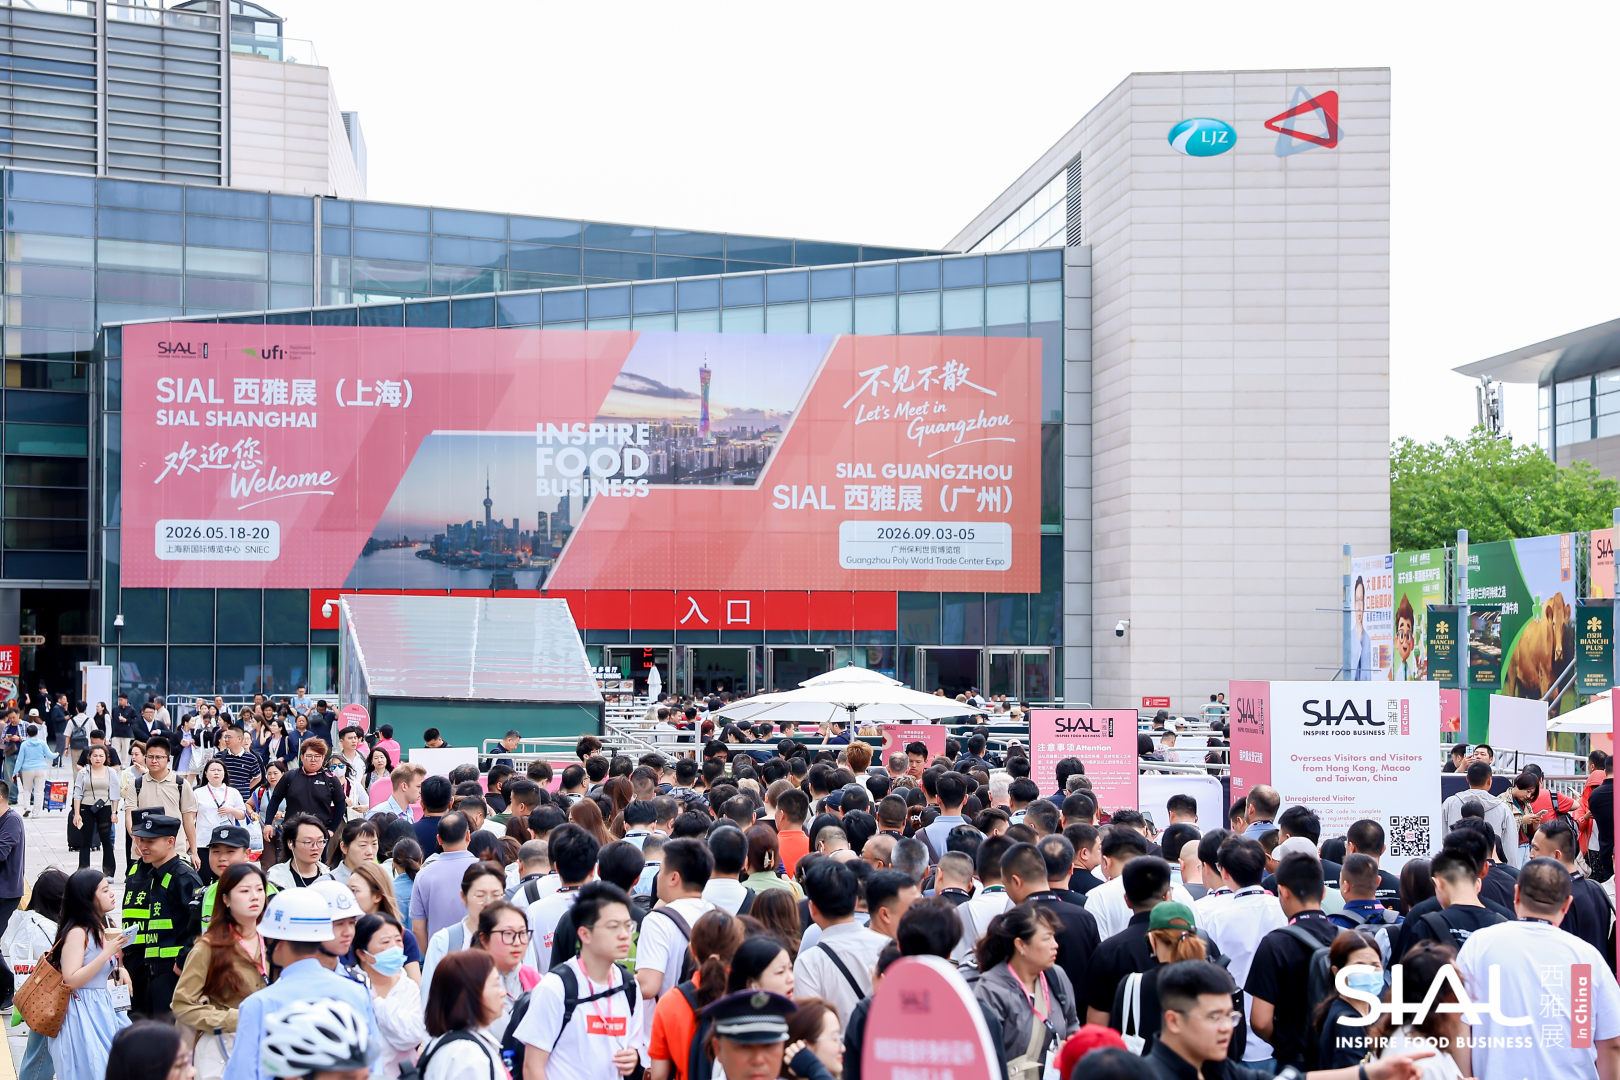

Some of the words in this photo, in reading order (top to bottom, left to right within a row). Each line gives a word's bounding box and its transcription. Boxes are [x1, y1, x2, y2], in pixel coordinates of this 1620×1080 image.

[1201, 131, 1229, 145] LJZ
[157, 342, 197, 355] SIAL
[156, 377, 224, 404] SIAL
[843, 359, 997, 408] 不见不散
[156, 410, 199, 426] SIAL
[205, 411, 317, 428] SHANGHAI
[854, 404, 890, 425] Let's
[894, 401, 930, 419] Meet
[933, 400, 947, 413] in
[536, 423, 650, 445] INSPIRE
[906, 409, 1013, 447] Guangzhou
[154, 437, 264, 484] 欢迎您
[536, 446, 650, 477] FOOD
[835, 463, 877, 479] SIAL
[881, 464, 1013, 480] GUANGZHOU
[230, 466, 339, 498] Welcome
[536, 478, 650, 497] BUSINESS
[772, 485, 836, 510] SIAL
[165, 526, 270, 539] 2026.05.18-20
[877, 527, 975, 540] 2026.09.03-05
[244, 545, 270, 554] SNIEC
[1597, 539, 1613, 558] SIA
[846, 556, 890, 565] Guangzhou
[893, 556, 909, 565] Poly
[911, 556, 933, 564] World
[936, 556, 957, 564] Trade
[958, 557, 983, 565] Center
[985, 557, 1005, 567] Expo
[679, 596, 750, 625] 入口
[1236, 698, 1258, 725] SIAL
[1302, 699, 1386, 727] SIAL
[1387, 699, 1399, 736] 西雅展
[1054, 718, 1100, 733] SIAL
[1037, 744, 1075, 752] 注意事项
[1076, 743, 1112, 752] Attention
[1290, 754, 1332, 762] Overseas
[1334, 754, 1367, 762] Visitors
[1389, 754, 1423, 762] Visitors
[1326, 765, 1350, 774] Hong
[1352, 765, 1378, 774] Kong,
[1335, 775, 1370, 784] Taiwan,
[1284, 795, 1331, 803] Unregistered
